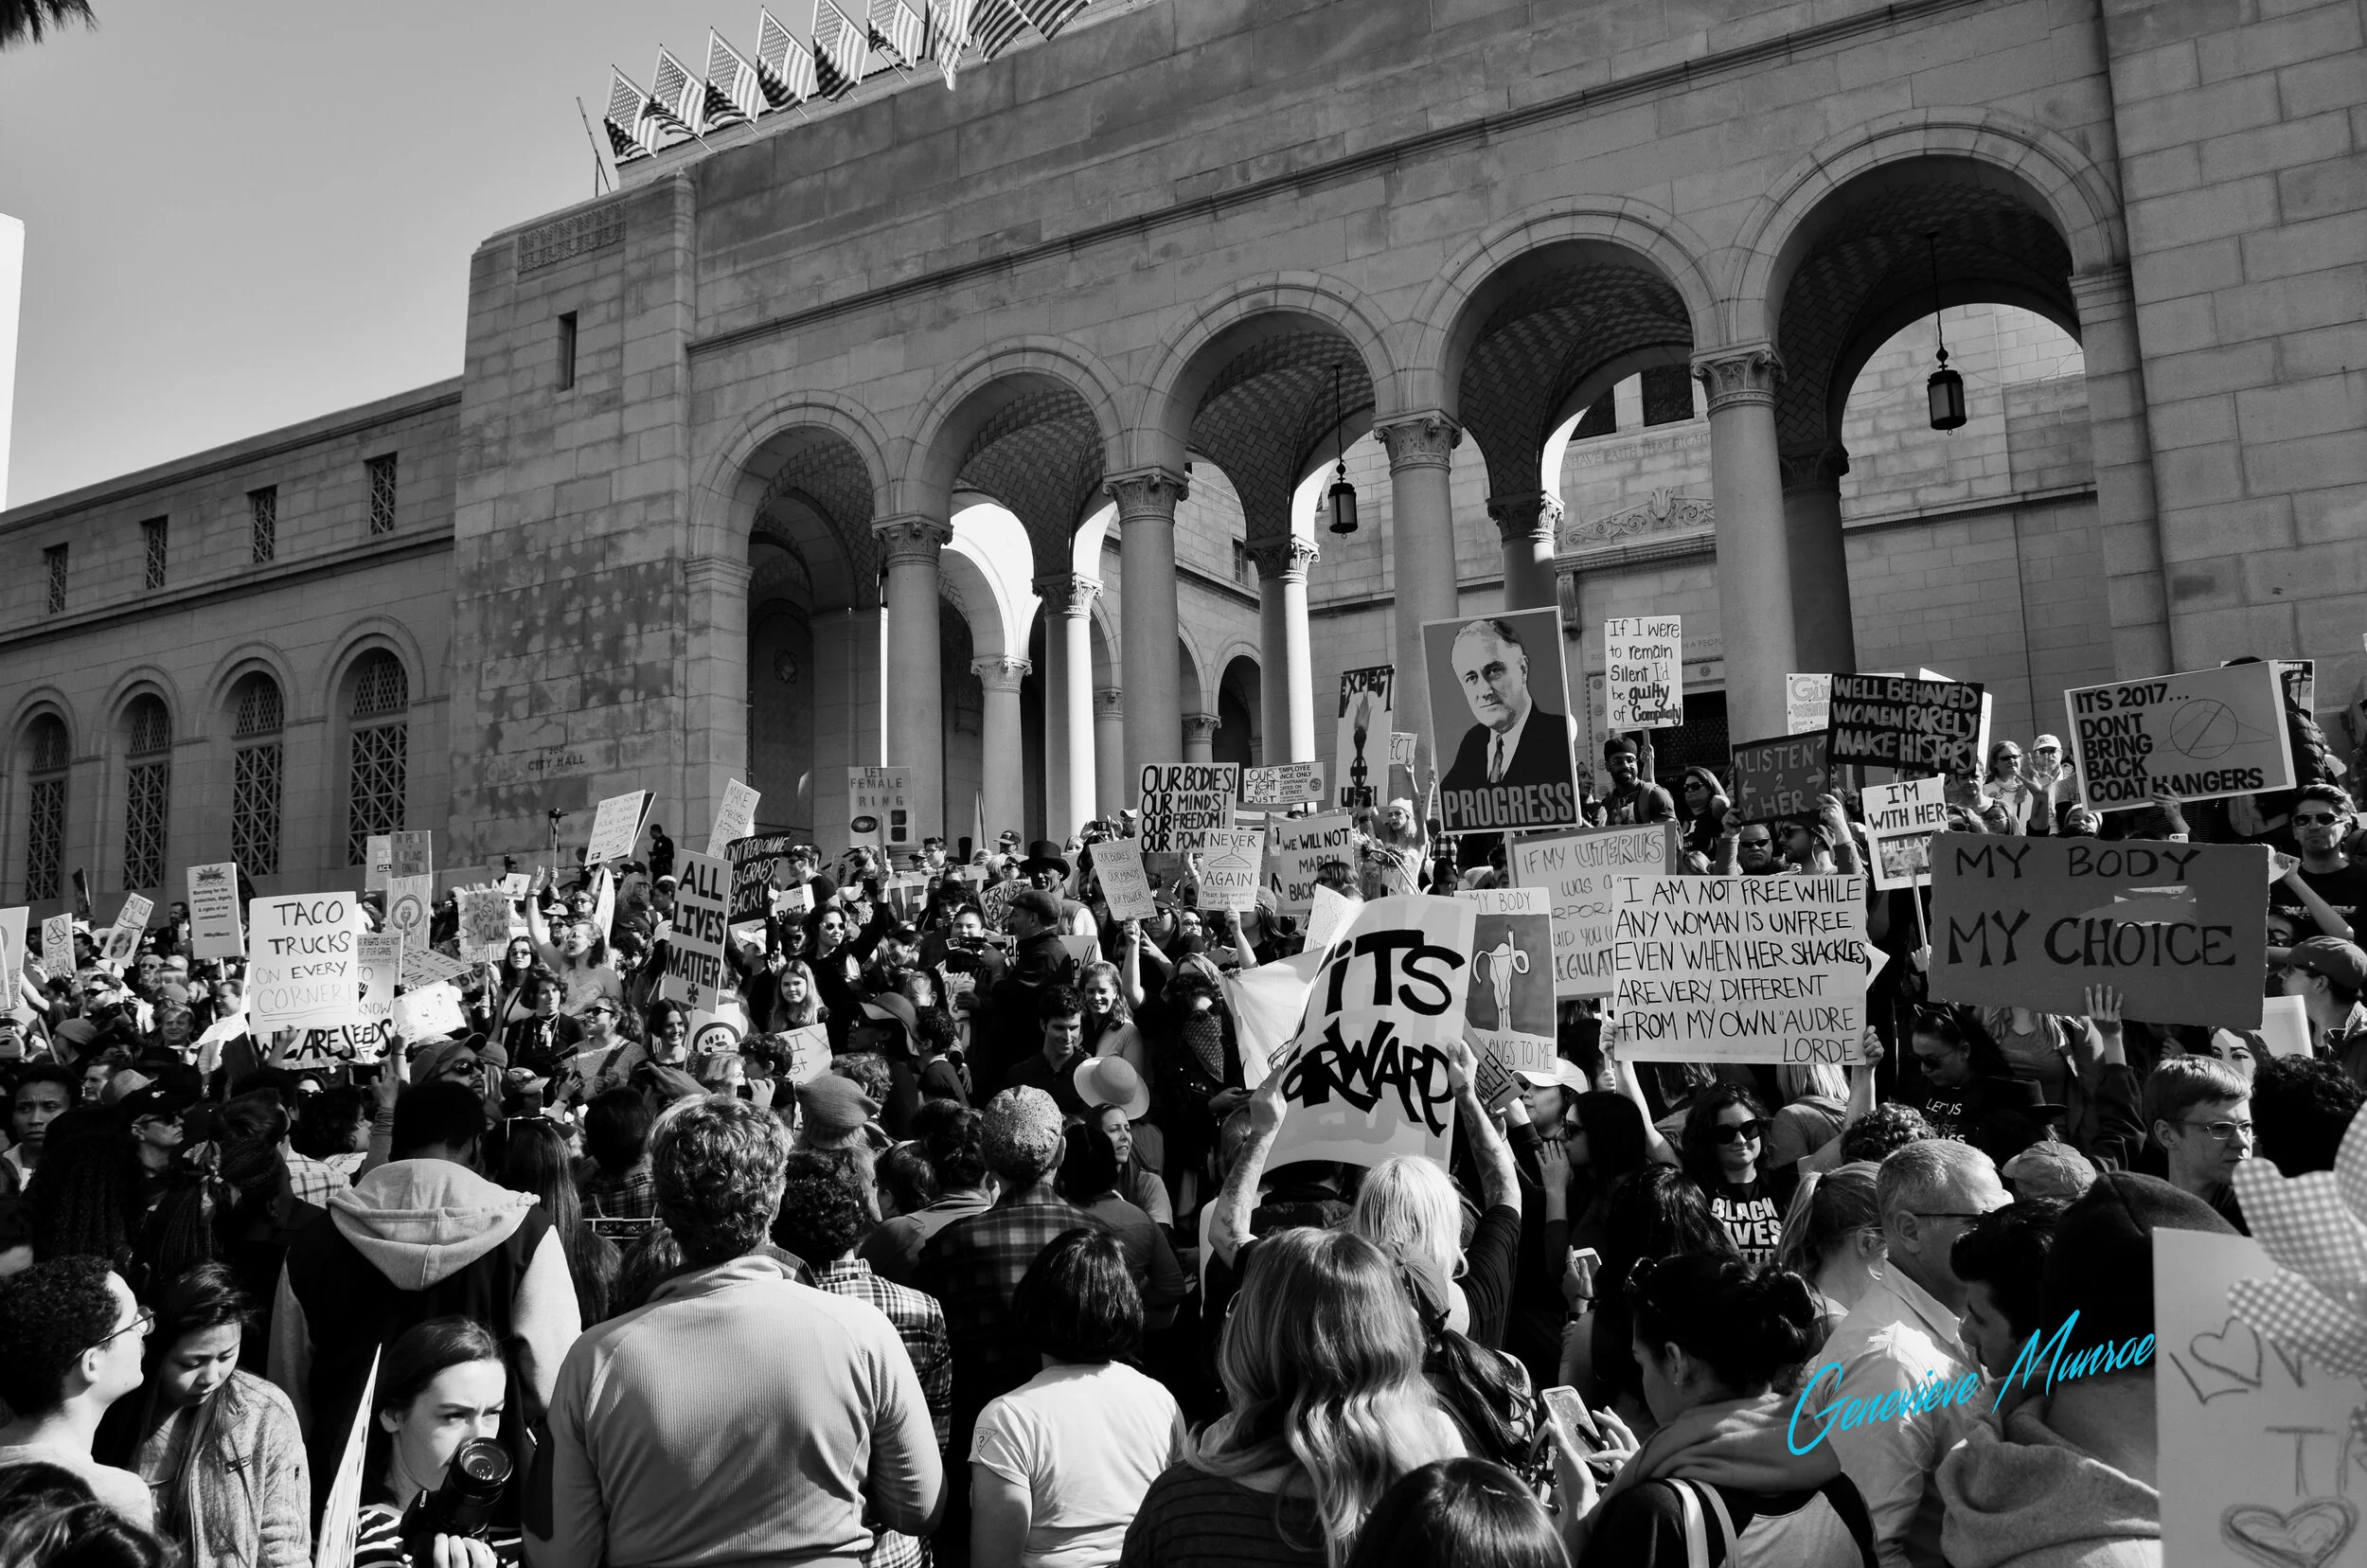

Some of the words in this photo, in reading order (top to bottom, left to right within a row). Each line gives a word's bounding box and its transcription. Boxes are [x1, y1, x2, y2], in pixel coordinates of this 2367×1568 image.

[1632, 618, 1643, 636] I
[1647, 623, 1680, 637] were
[1610, 645, 1622, 658] to
[1628, 644, 1673, 660] remain
[1611, 665, 1648, 683] Silent
[1338, 668, 1395, 718] EXPECT
[1611, 686, 1626, 701] be
[1628, 683, 1669, 708] guilty
[1833, 676, 1883, 701] WELL
[1887, 679, 1978, 709] BEHAVED
[2075, 689, 2113, 714] IT'S
[1613, 705, 1628, 722] of
[1833, 702, 1904, 728] WOMEN
[1905, 705, 1978, 741] RARELY
[2079, 711, 2144, 739] DON'T
[1745, 744, 1815, 773] LISTEN
[1833, 728, 1896, 757] MAKE
[1899, 733, 1979, 775] HISTORY
[2082, 733, 2153, 761] BRING
[528, 758, 552, 771] CITY
[556, 755, 585, 768] HALL
[864, 767, 884, 778] LET
[1249, 769, 1275, 781] OUR
[2085, 757, 2148, 782] BACK
[850, 778, 902, 789] FEMALE
[1142, 765, 1182, 793] OUR
[1184, 765, 1237, 794] BODIES!
[1774, 774, 1787, 793] 2
[2089, 776, 2147, 803] COAT
[2151, 767, 2264, 796] HANGERS
[859, 795, 903, 807] RING
[1142, 793, 1173, 816] OUR
[1177, 793, 1227, 811] MINDS!
[1444, 782, 1575, 829] PROGRESS
[1759, 790, 1810, 816] HER
[1885, 782, 1920, 805] I'M
[1142, 814, 1172, 834] OUR
[1172, 811, 1226, 829] FREEDOM!
[1868, 807, 1908, 831] WITH
[1914, 804, 1947, 826] HER
[1141, 832, 1171, 852] OUR
[1176, 831, 1205, 849] POWE
[1210, 832, 1256, 847] NEVER
[1283, 838, 1297, 851] WE
[1299, 833, 1322, 848] WILL
[1324, 828, 1350, 847] NOT
[1523, 849, 1539, 874] IF
[1543, 846, 1565, 872] MY
[1575, 830, 1664, 868] UTERUS
[1882, 835, 1931, 853] HILLAR
[742, 857, 780, 884] GRABS
[1955, 843, 2032, 879] MY
[2068, 846, 2202, 882] BODY
[677, 860, 722, 901] ALL
[1203, 870, 1254, 886] AGAIN
[728, 884, 763, 918] BACK!
[1470, 892, 1488, 913] MY
[1499, 891, 1531, 913] BODY
[1652, 879, 1690, 906] AM
[1699, 880, 1738, 904] NOT
[1741, 878, 1793, 906] FREE
[1794, 878, 1861, 903] WHILE
[273, 900, 345, 926] TACO
[671, 900, 726, 945] LIVES
[1615, 908, 1659, 938] ANY
[1664, 910, 1739, 936] WOMAN
[1745, 910, 1764, 933] IS
[1769, 910, 1856, 935] UNFREE,
[268, 930, 352, 955] TRUCKS
[1948, 909, 2031, 968] MY
[2044, 917, 2235, 968] CHOICE
[666, 944, 721, 989] MATTER
[1556, 948, 1613, 983] EGULAT
[1615, 940, 1674, 971] EVEN
[1680, 939, 1742, 972] WHEN
[1744, 942, 1789, 971] HER
[1791, 938, 1866, 966] SHACKLES
[256, 967, 280, 985] ON
[291, 960, 347, 980] EVERY
[458, 964, 485, 987] BIG
[258, 982, 351, 1014] CORNER!
[1616, 978, 1662, 1007] ARE
[1661, 978, 1712, 1004] VERY
[1720, 974, 1828, 1002] DIFFERENT
[358, 1001, 392, 1016] KNOW
[1617, 1010, 1678, 1042] FROM
[1686, 1007, 1716, 1039] MY
[1783, 1007, 1857, 1035] AUDRE
[336, 1018, 392, 1060] SEEDS
[1784, 1039, 1858, 1064] LORDE
[1521, 1041, 1533, 1066] TO
[1538, 1042, 1553, 1070] ME
[1926, 1097, 1947, 1113] LET
[1946, 1102, 1963, 1115] US
[1712, 1197, 1779, 1221] BLACK
